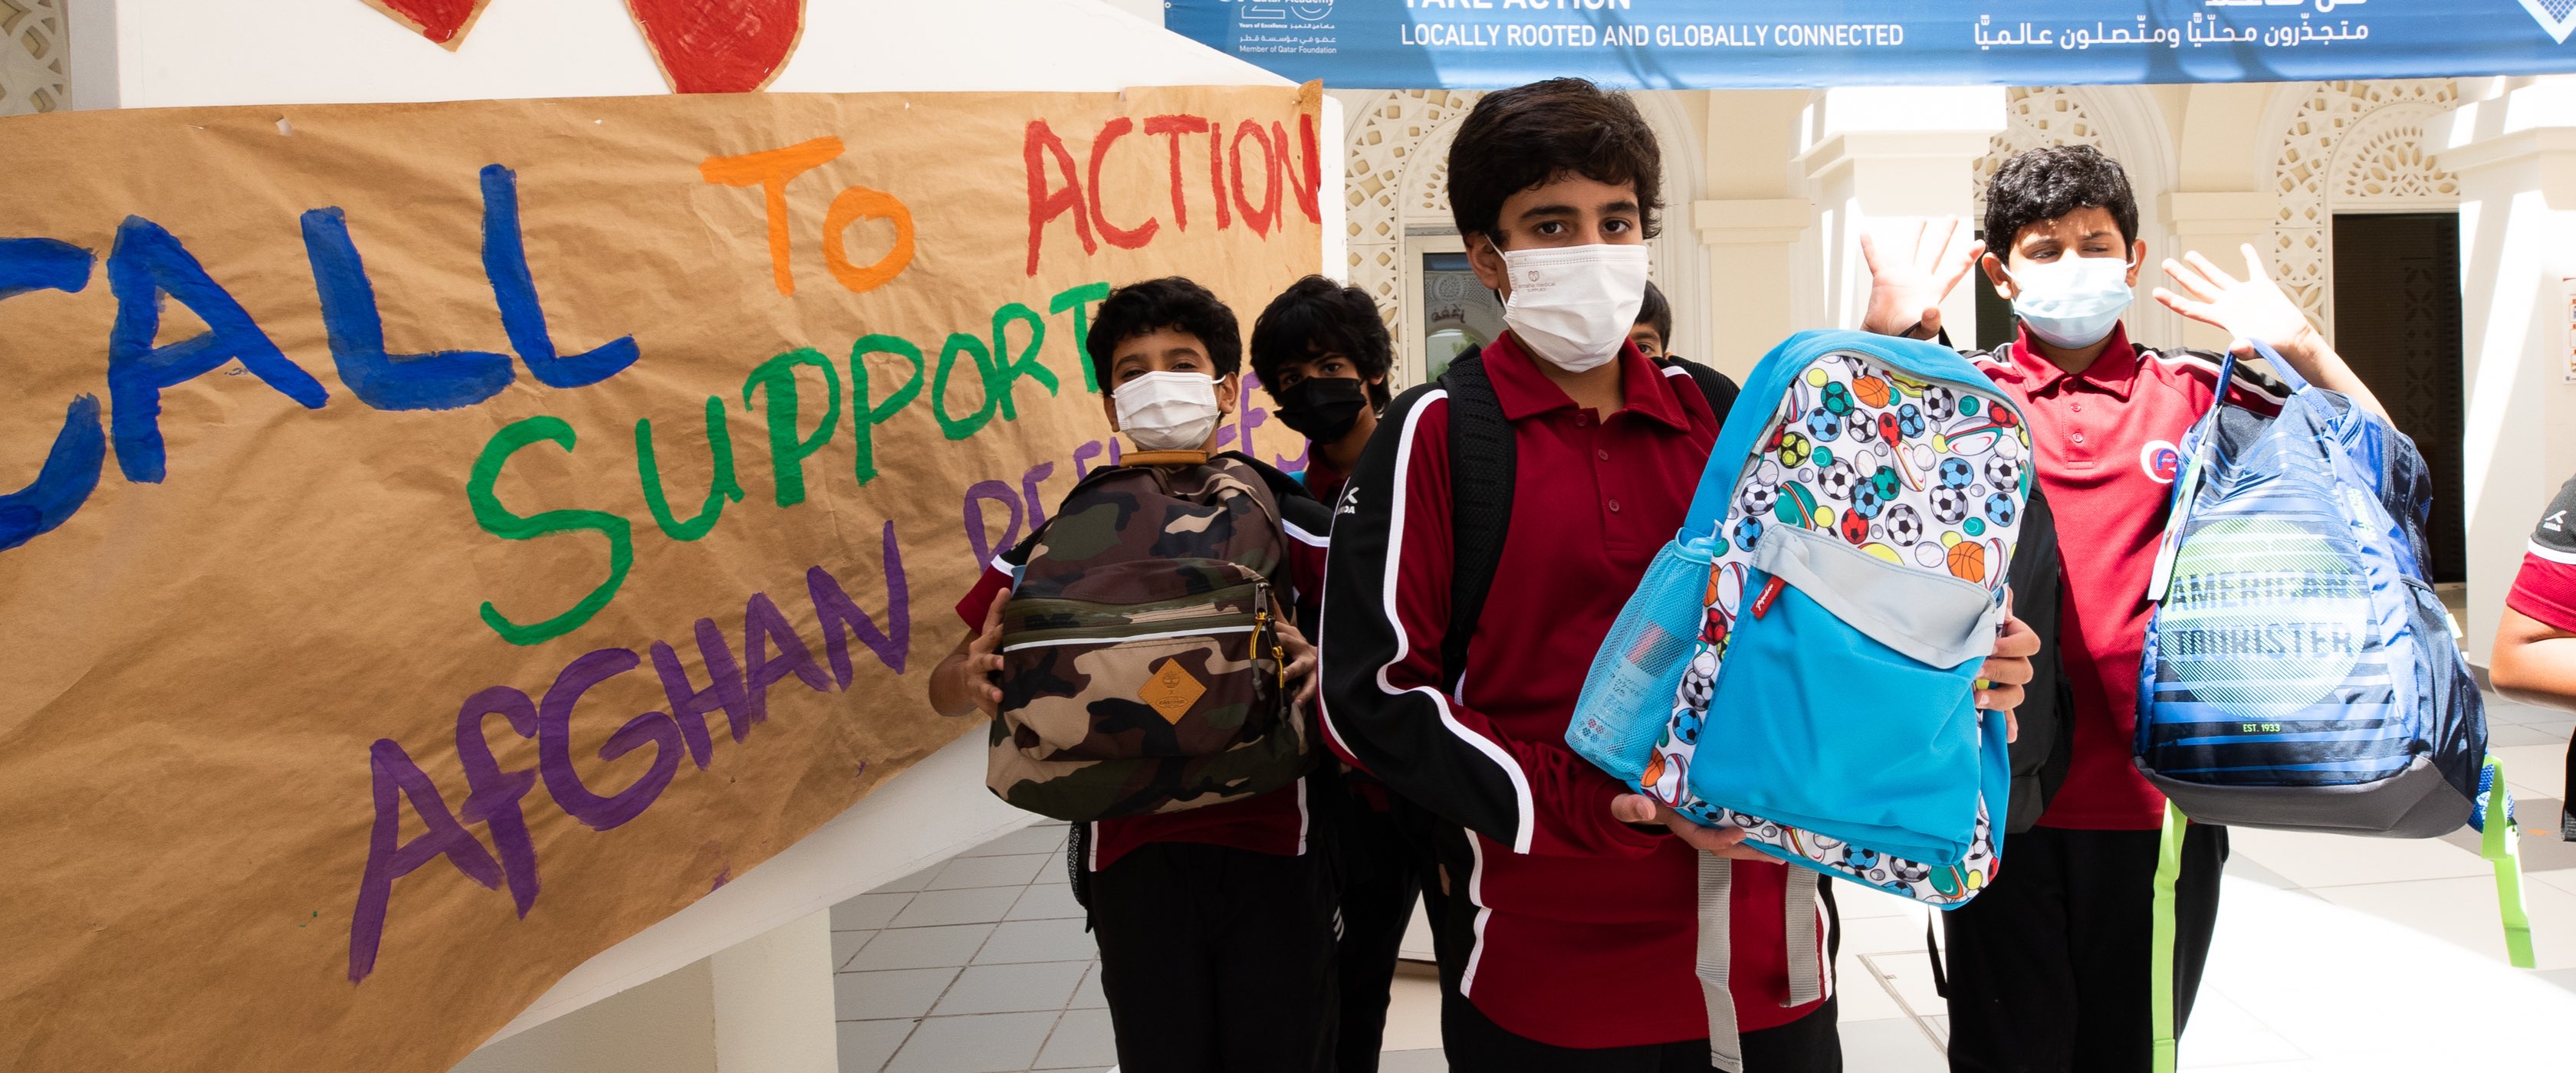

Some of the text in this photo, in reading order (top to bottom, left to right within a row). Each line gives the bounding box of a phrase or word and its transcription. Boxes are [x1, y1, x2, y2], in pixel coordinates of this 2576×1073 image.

[1401, 24, 1903, 46] LOCALLY ROOTED AND GLOBALLY CONNECTED
[1024, 113, 1322, 277] ACTION
[466, 281, 1111, 646] SUPPORT
[2242, 724, 2281, 732] EST. 1933
